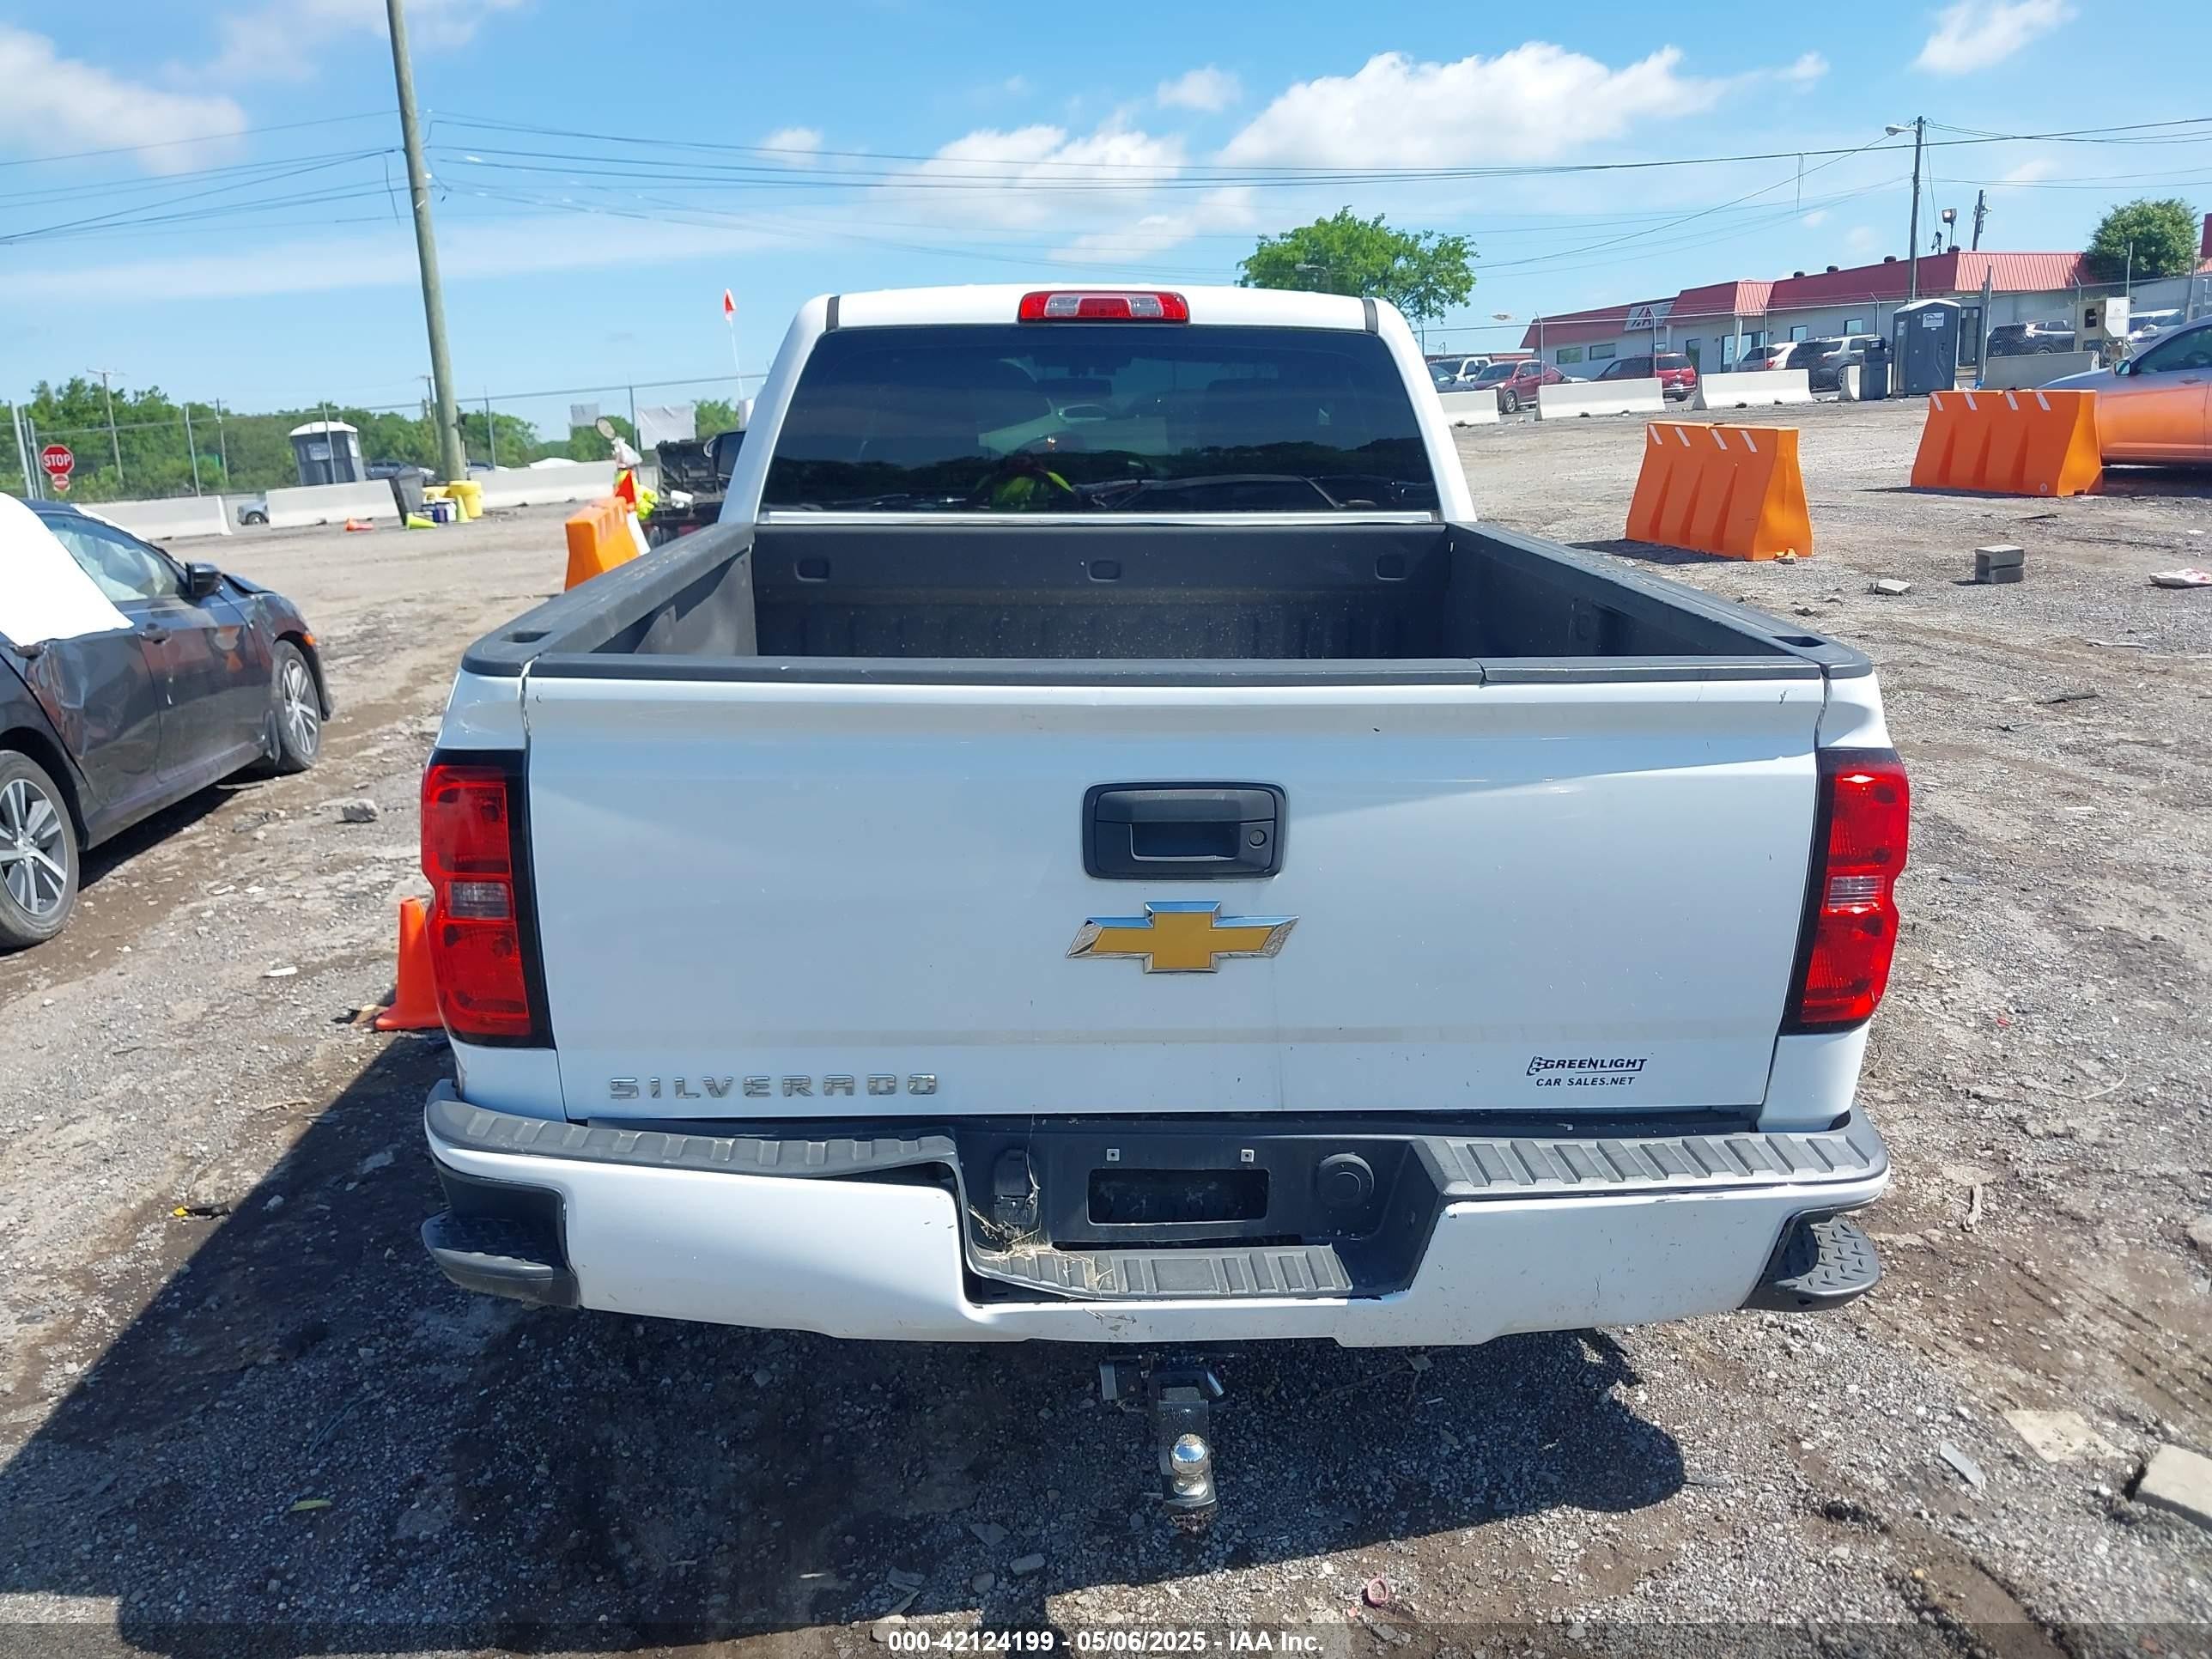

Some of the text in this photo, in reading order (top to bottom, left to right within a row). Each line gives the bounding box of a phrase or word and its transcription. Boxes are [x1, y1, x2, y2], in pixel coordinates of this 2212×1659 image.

[44, 453, 70, 467] STOP
[1543, 1056, 1648, 1072] GREENLIGHT
[610, 1073, 937, 1099] SILVERADO
[1536, 1077, 1635, 1086] CAR SALES.NET
